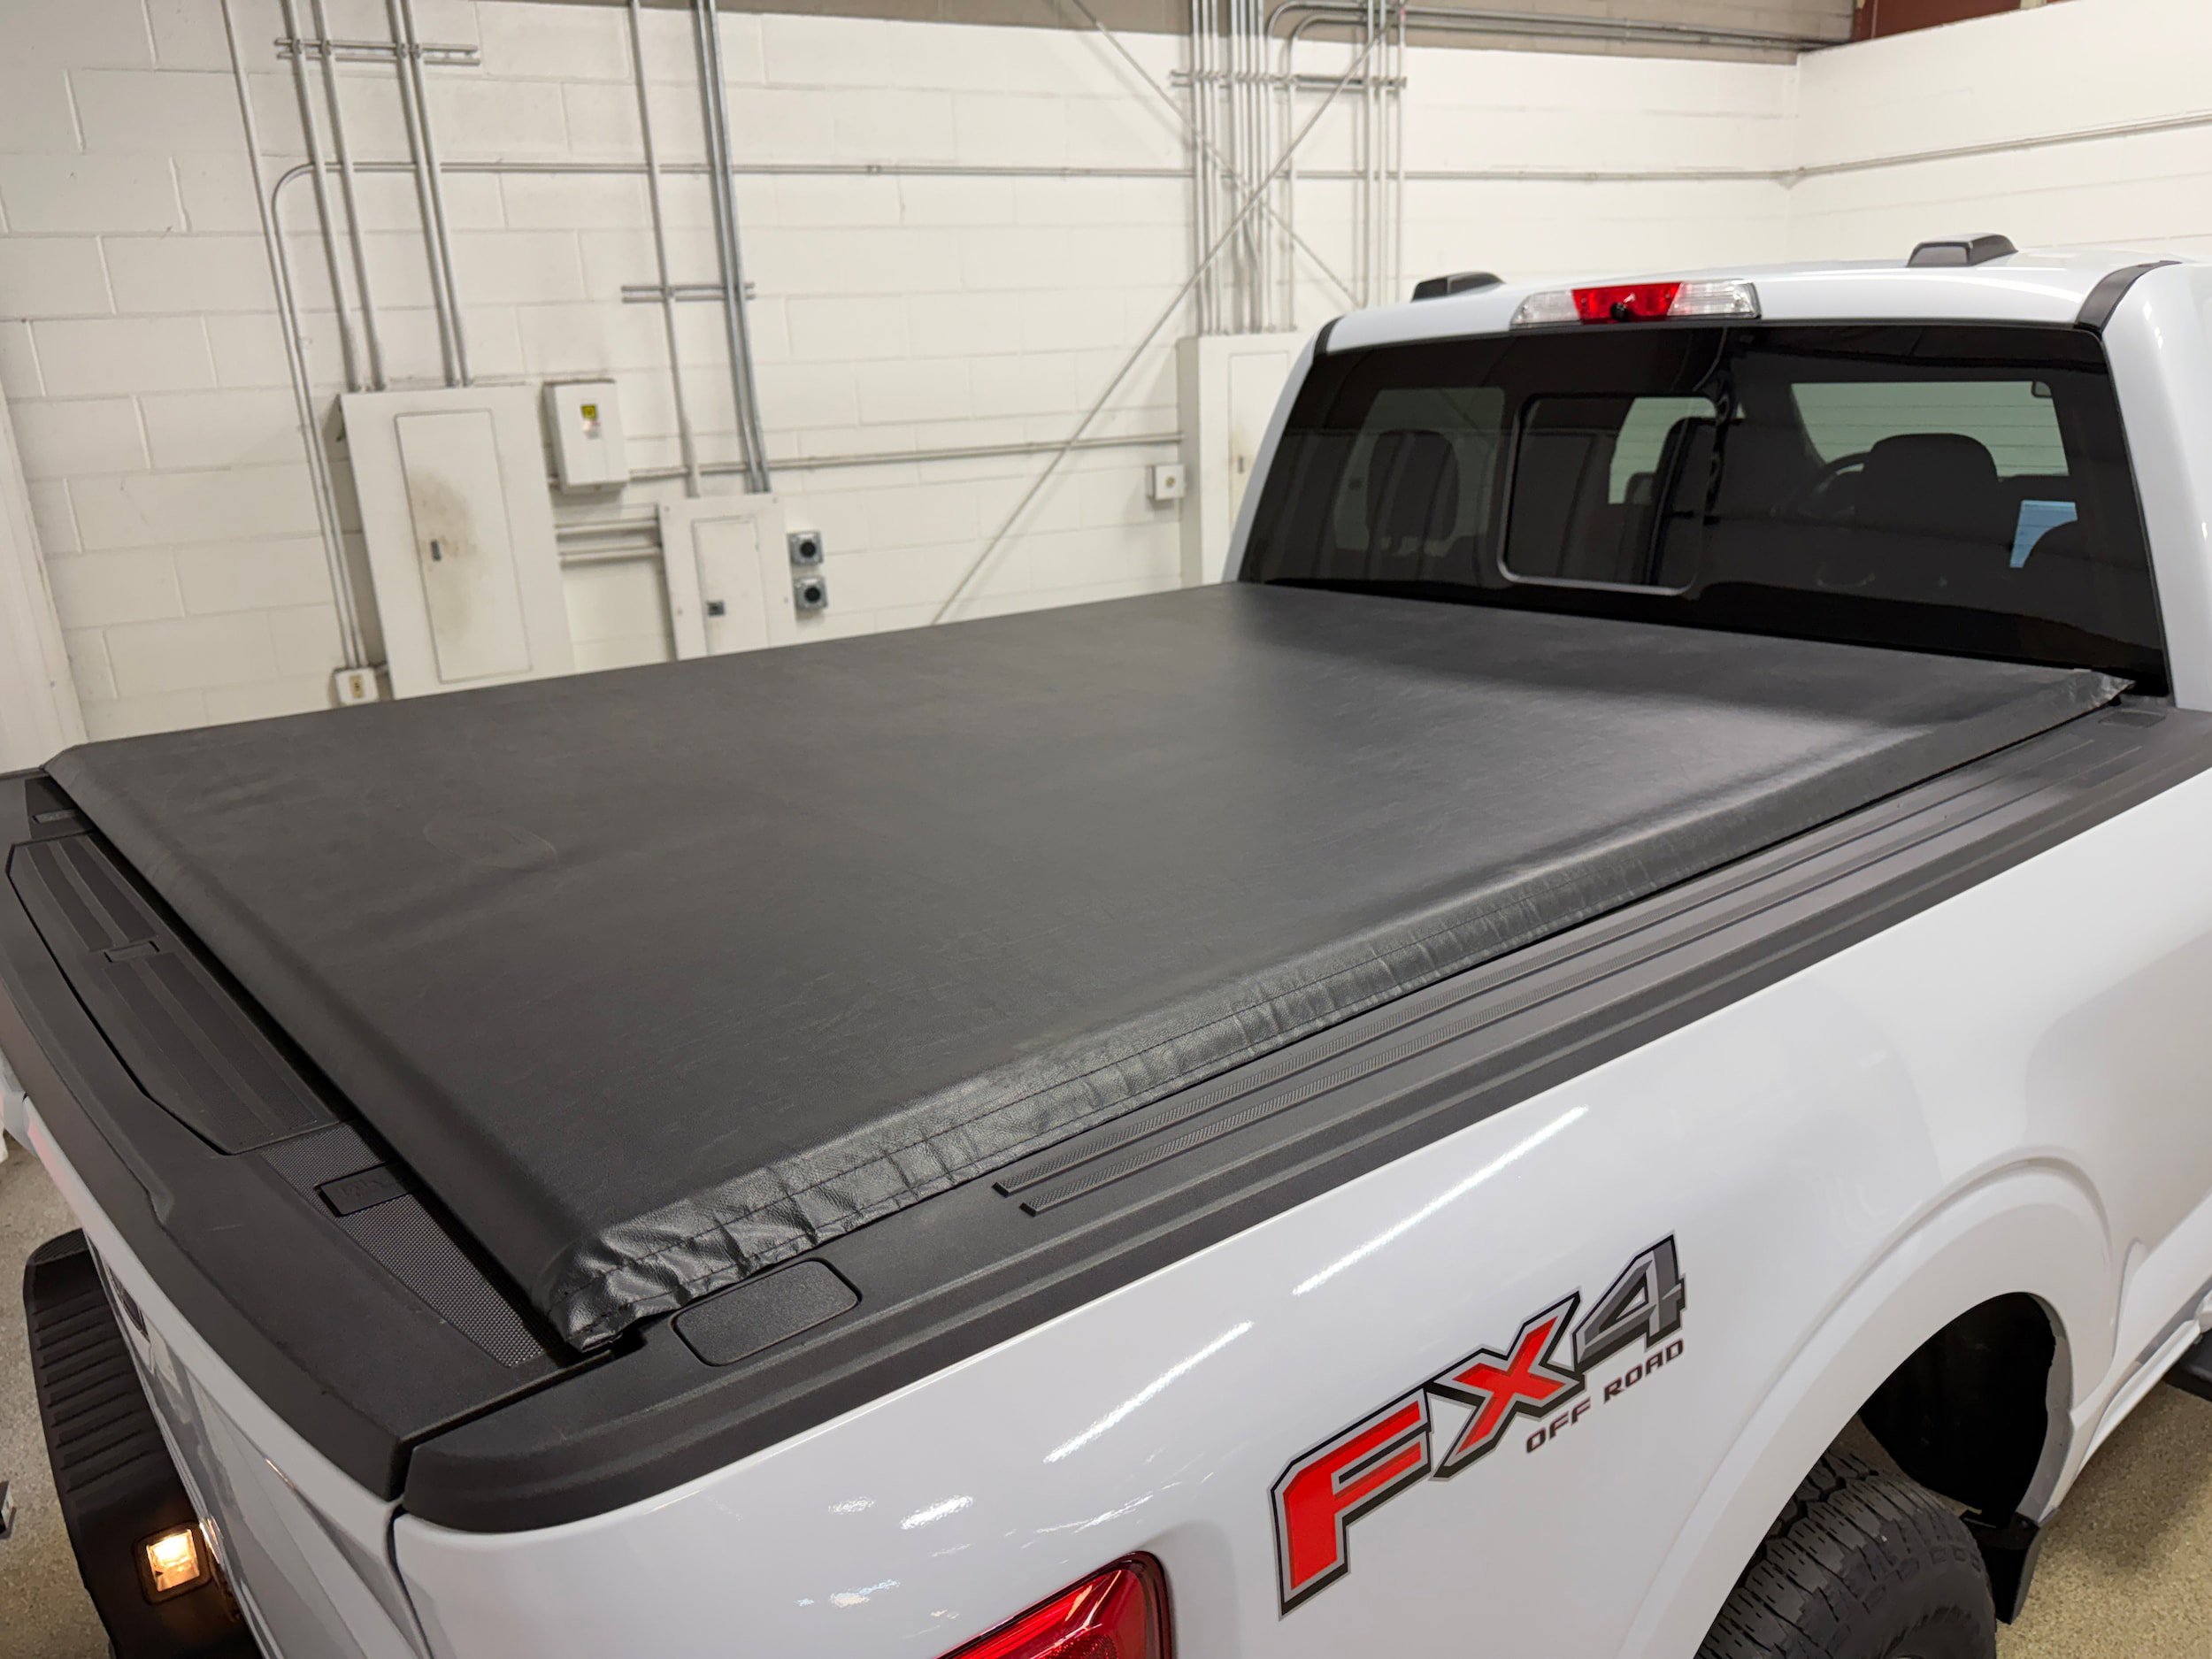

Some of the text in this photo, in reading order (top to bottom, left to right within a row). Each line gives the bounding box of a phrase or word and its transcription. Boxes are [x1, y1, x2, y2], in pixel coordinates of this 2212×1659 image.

[1268, 1231, 1686, 1620] FX4
[1526, 1338, 1684, 1454] OFF ROAD
